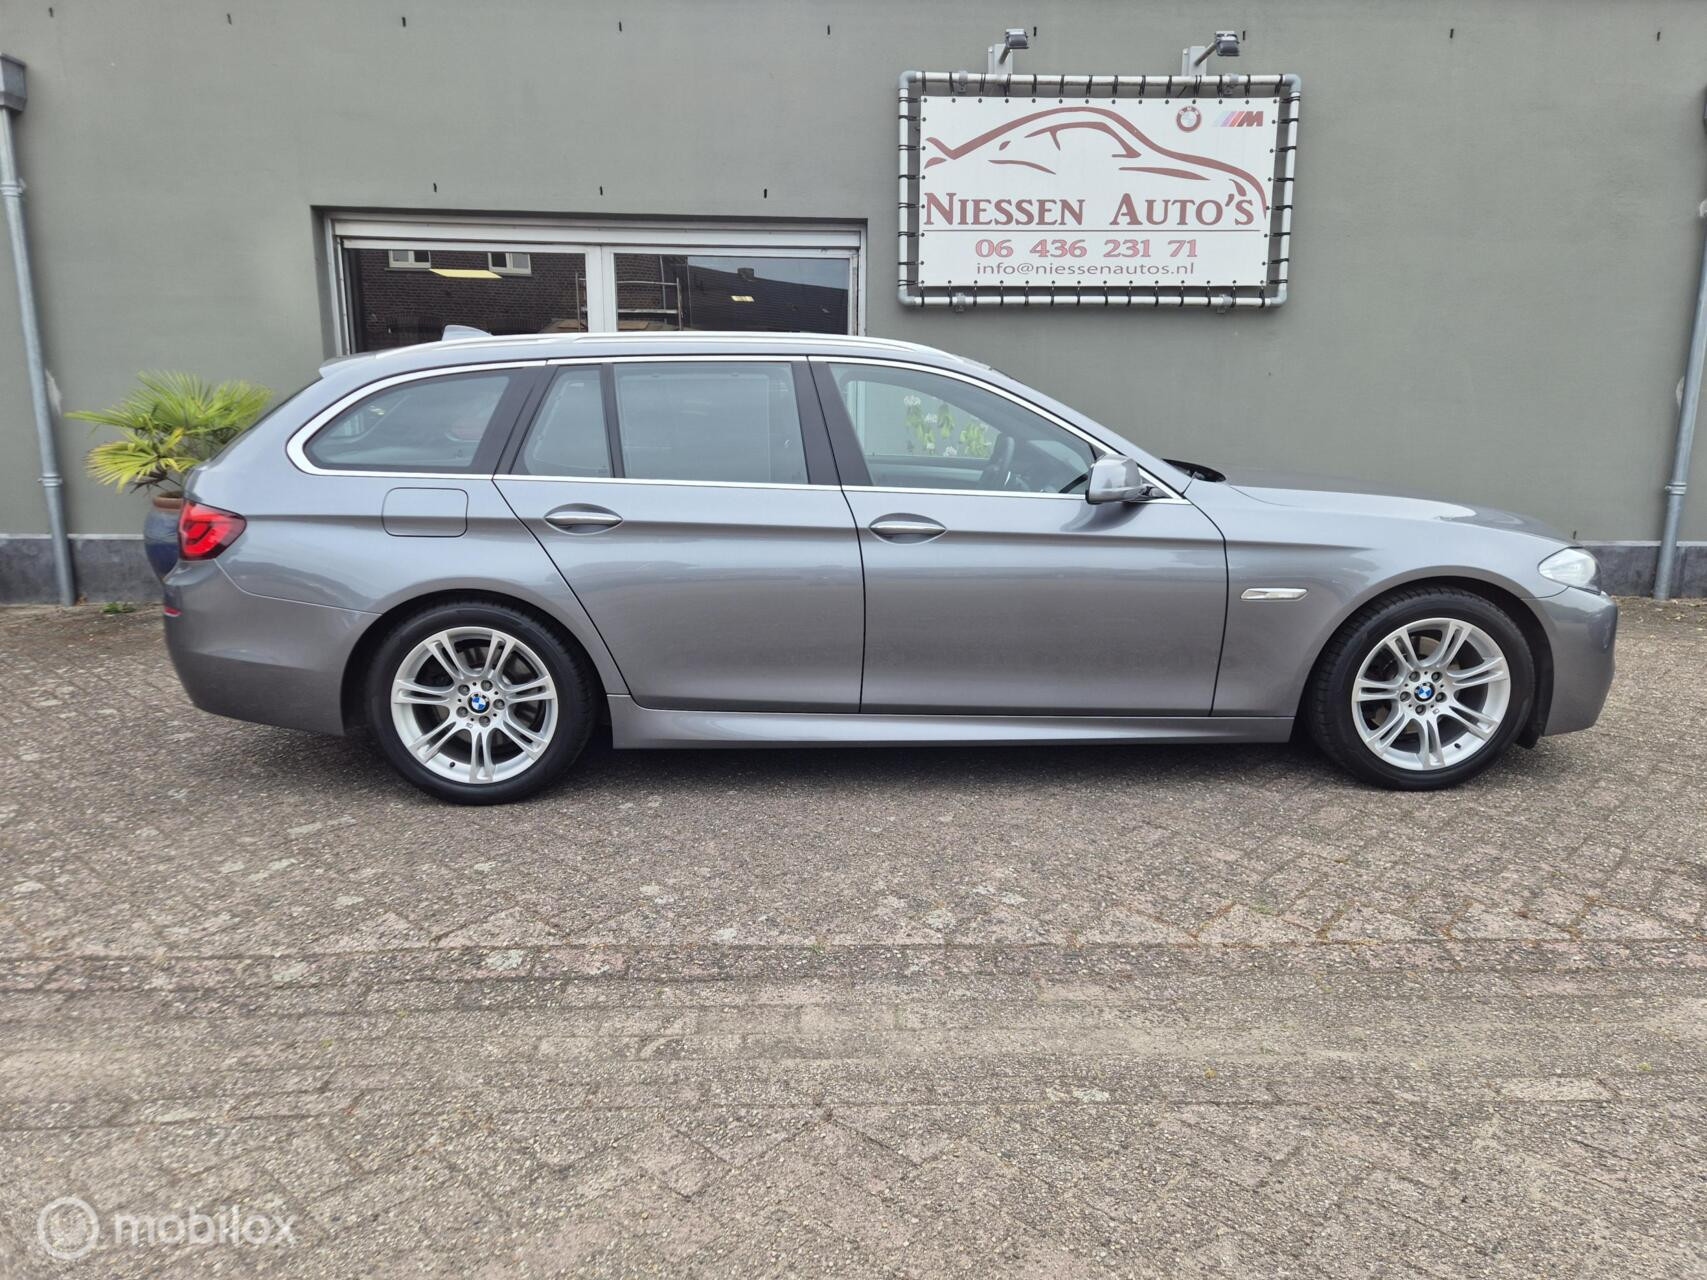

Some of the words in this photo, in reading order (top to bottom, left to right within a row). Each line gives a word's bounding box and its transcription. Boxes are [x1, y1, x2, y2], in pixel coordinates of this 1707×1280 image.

[923, 192, 1086, 226] NIESSEN
[1109, 193, 1255, 226] AUTO'S
[975, 239, 1014, 258] 06
[1029, 239, 1088, 258] 436
[1103, 239, 1152, 258] 231
[1167, 239, 1198, 258] 71
[976, 262, 1195, 275] info@niessenautos.nl
